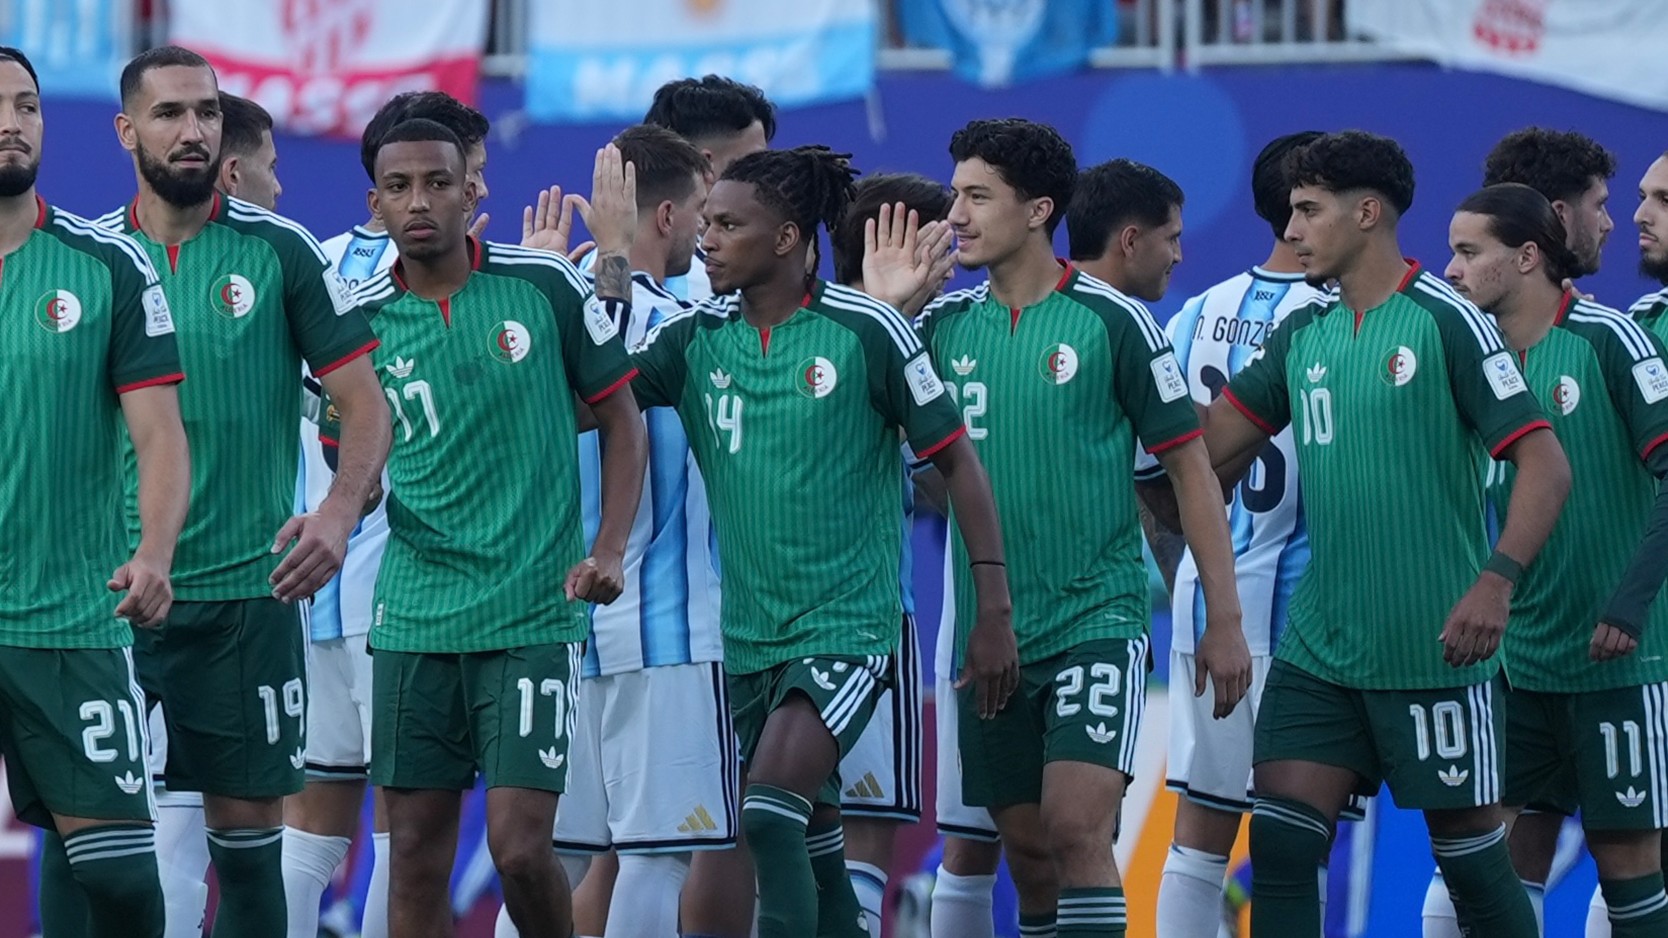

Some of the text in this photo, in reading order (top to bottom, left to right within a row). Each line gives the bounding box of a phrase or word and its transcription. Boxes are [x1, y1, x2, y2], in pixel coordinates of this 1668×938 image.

[384, 379, 440, 442] 17
[705, 392, 744, 454] 14
[1300, 387, 1334, 446] 10
[257, 677, 305, 745] 19
[517, 677, 565, 739] 17
[1055, 662, 1122, 718] 22
[79, 699, 139, 762] 21
[1409, 700, 1468, 761] 10
[1599, 720, 1643, 779] 11
